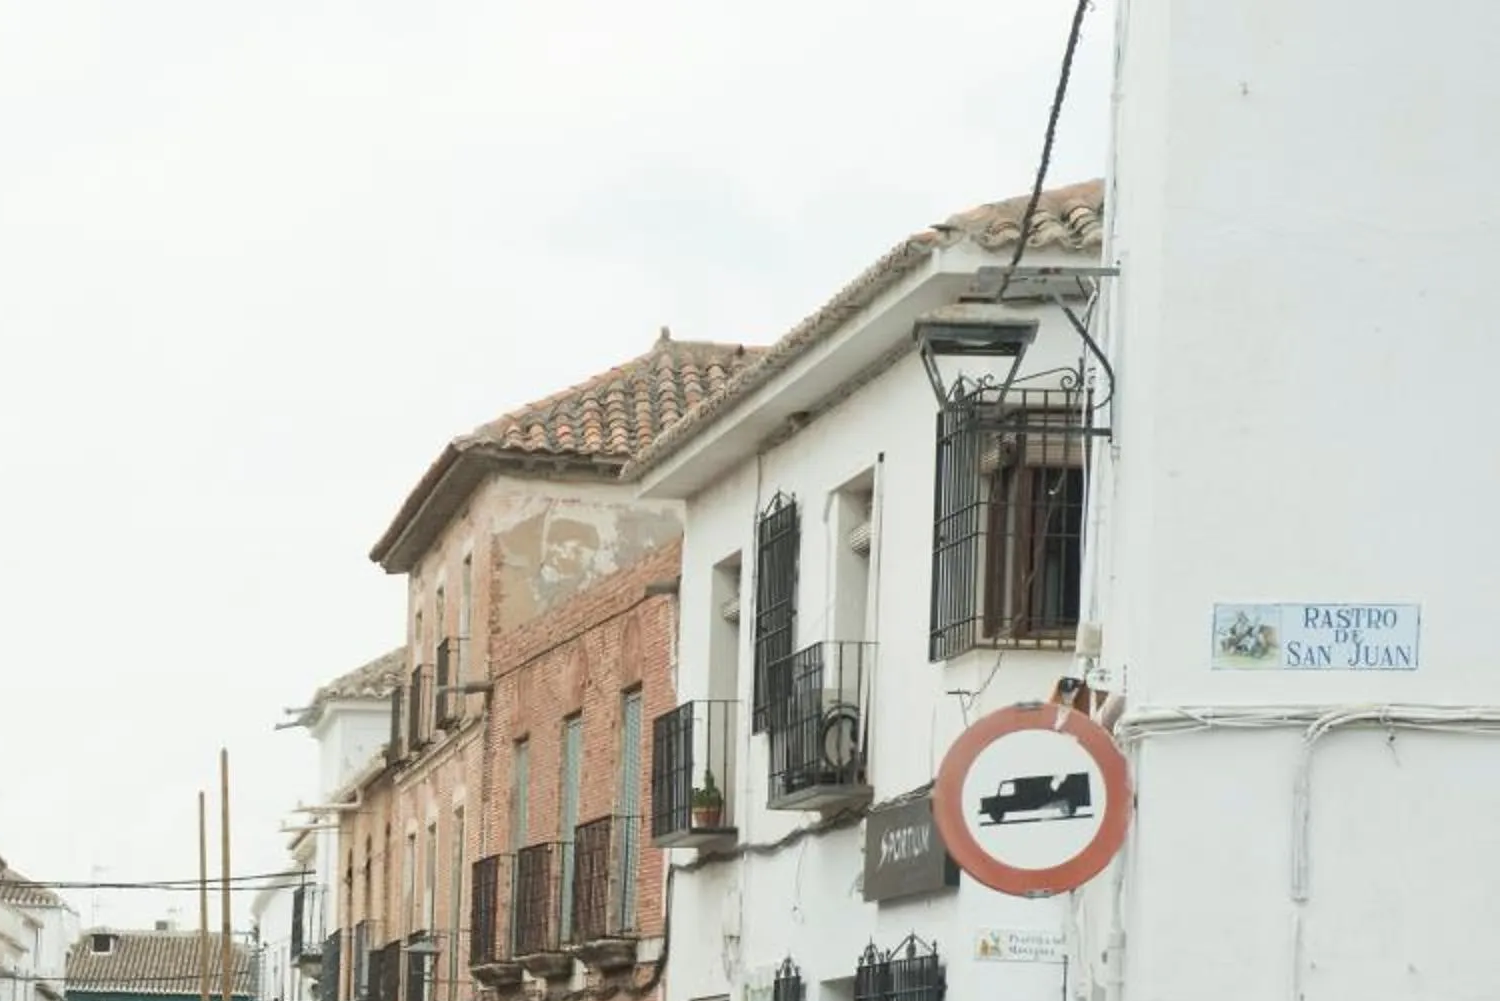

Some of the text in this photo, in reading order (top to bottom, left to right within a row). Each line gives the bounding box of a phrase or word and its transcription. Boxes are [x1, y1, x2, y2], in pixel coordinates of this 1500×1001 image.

[1304, 607, 1398, 629] RASTRO
[1334, 629, 1363, 643] DE
[1286, 640, 1411, 667] SAN JUAN
